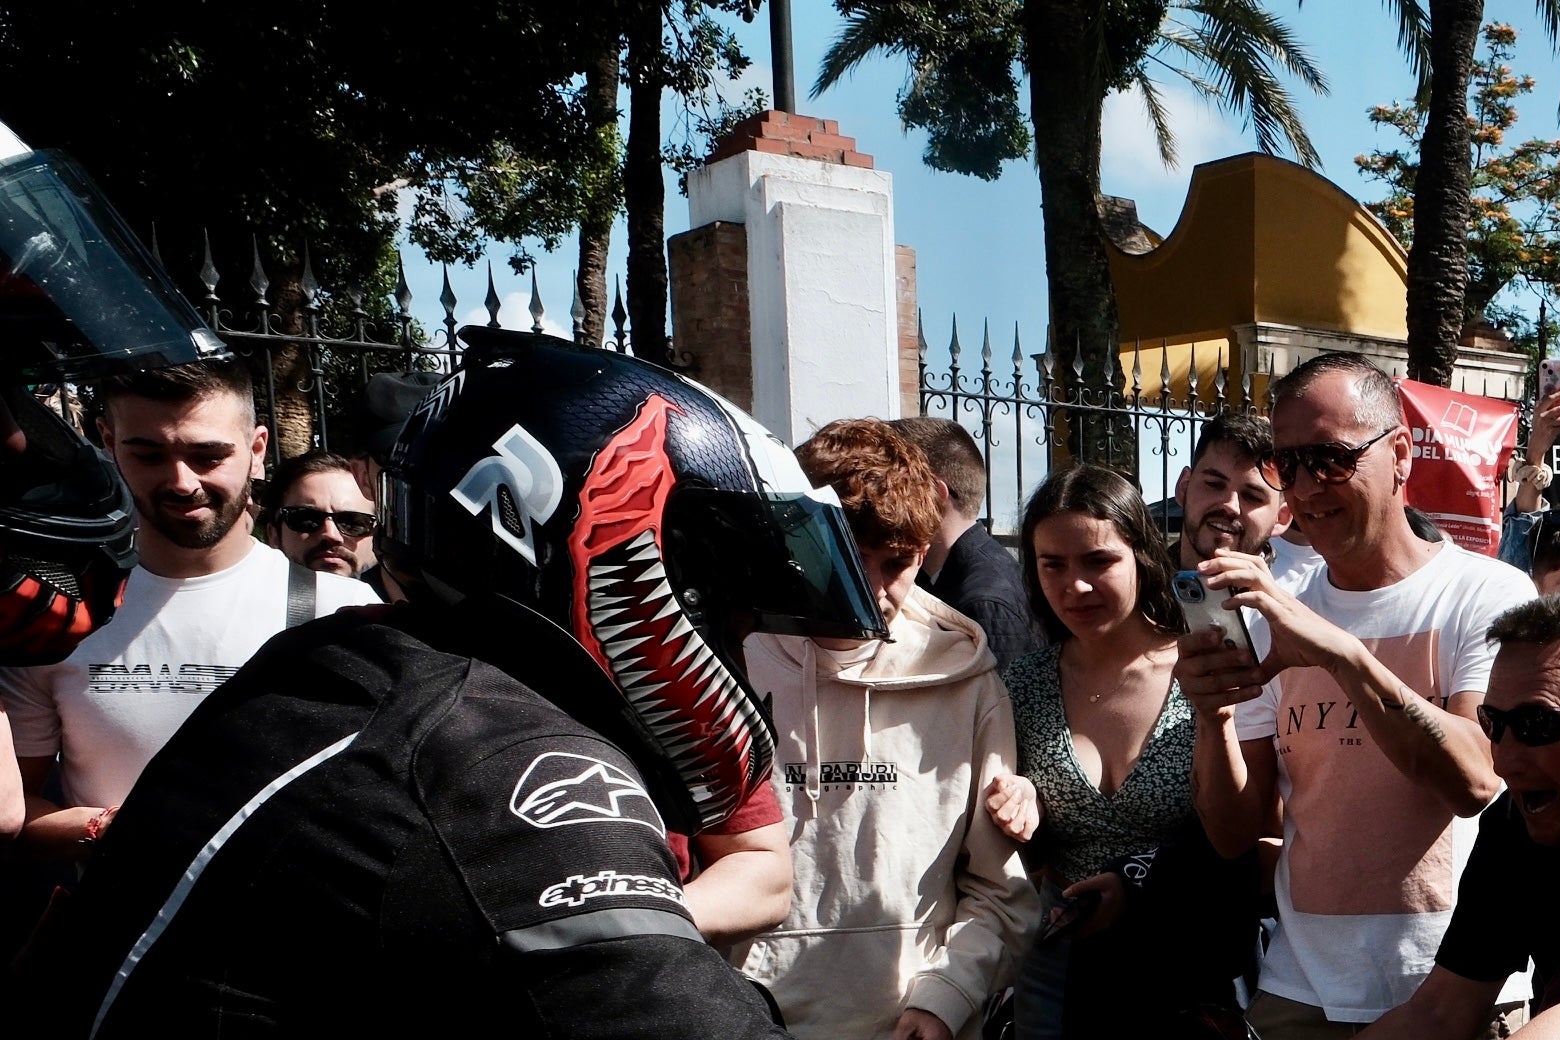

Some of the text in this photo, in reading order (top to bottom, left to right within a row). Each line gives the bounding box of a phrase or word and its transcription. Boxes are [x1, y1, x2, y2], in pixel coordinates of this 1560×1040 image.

[1412, 424, 1443, 444] DÍA
[1411, 445, 1441, 460] DEL
[1339, 738, 1362, 747] THE
[787, 763, 896, 782] NPAPIJRI
[785, 784, 897, 793] gegraphic
